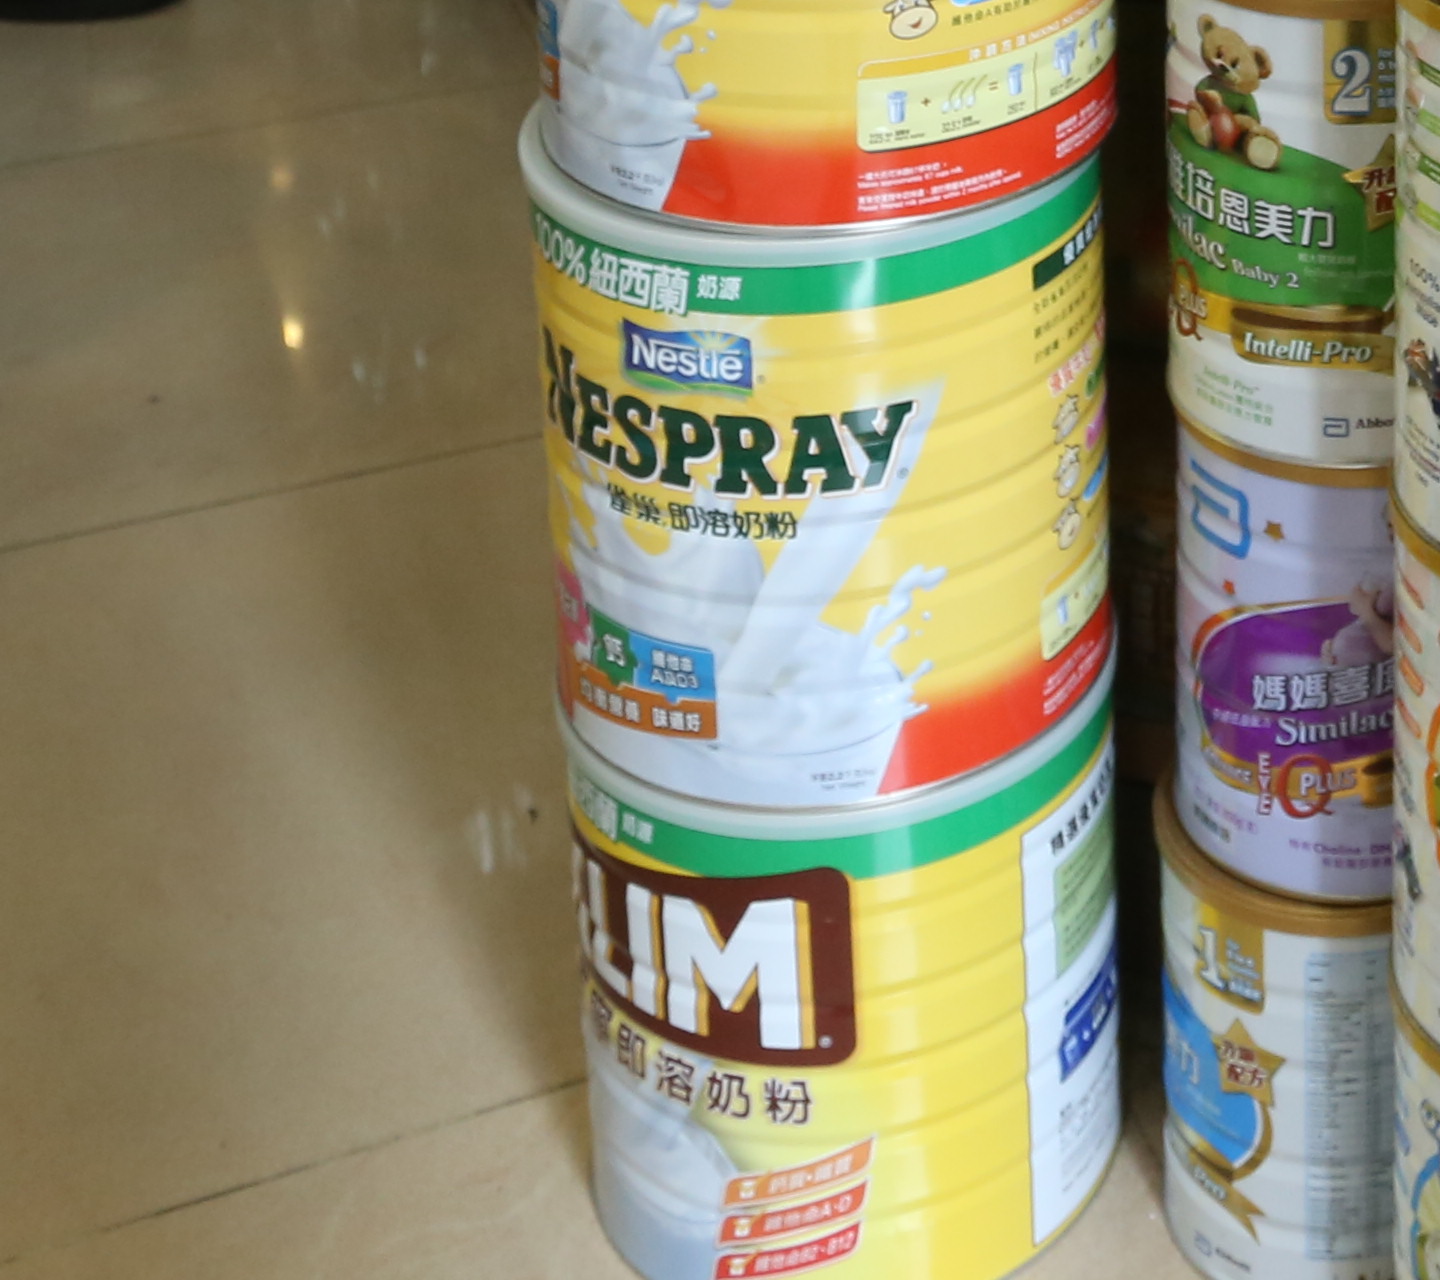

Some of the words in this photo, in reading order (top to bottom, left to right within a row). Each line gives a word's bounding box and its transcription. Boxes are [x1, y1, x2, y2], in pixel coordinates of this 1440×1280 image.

[1331, 47, 1373, 115] 2
[697, 274, 742, 301] 奶源
[1243, 330, 1373, 364] Intelli-Pro
[541, 325, 917, 498] NESPRAY
[1299, 766, 1359, 797] PLUS
